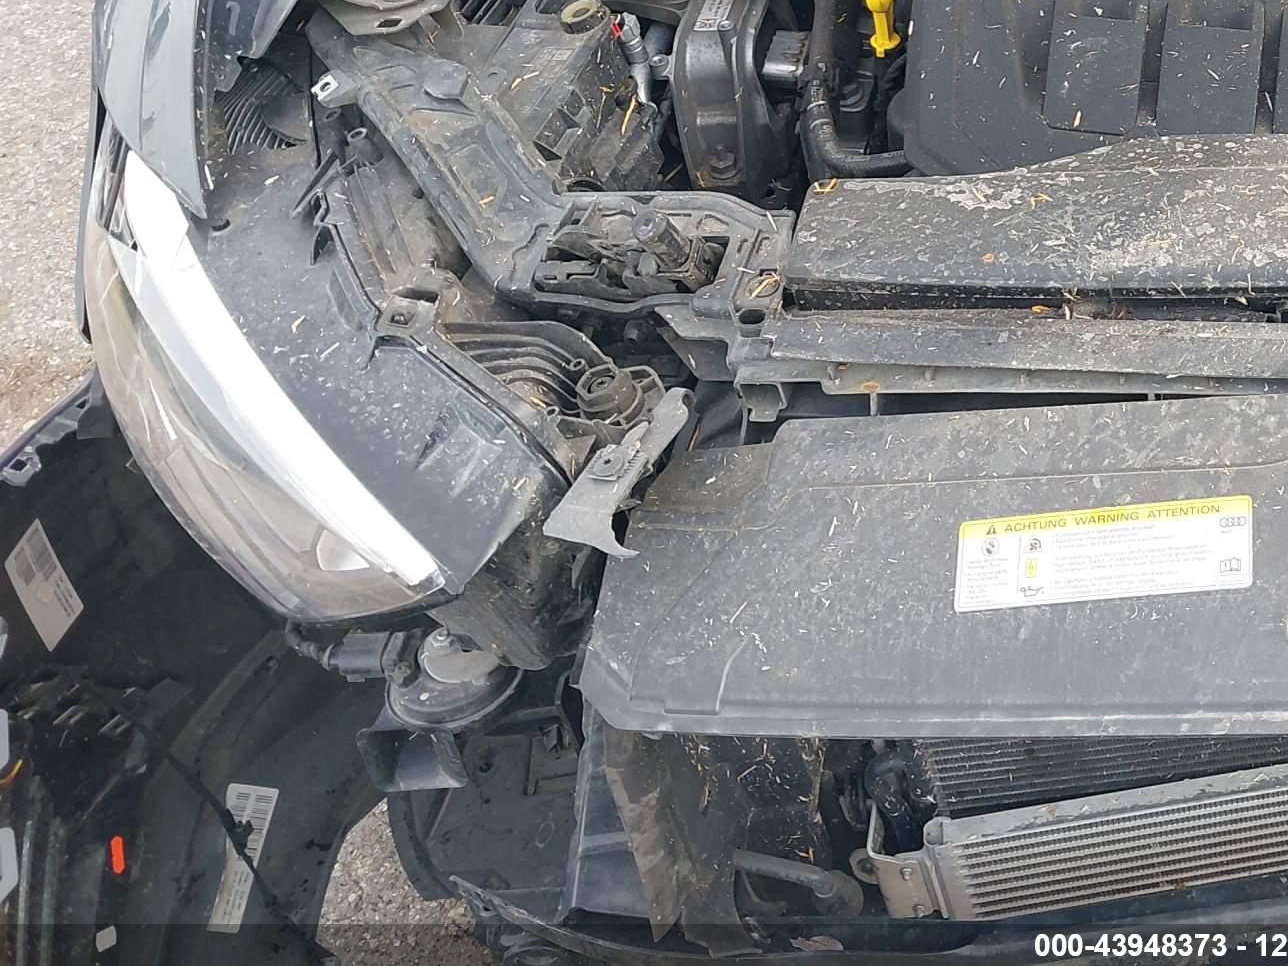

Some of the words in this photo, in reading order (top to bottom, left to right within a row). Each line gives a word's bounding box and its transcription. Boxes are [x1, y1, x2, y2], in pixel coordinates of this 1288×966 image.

[1004, 518, 1067, 533] ACHTUNG
[1074, 511, 1140, 526] WARNING
[1147, 505, 1221, 519] ATTENTION
